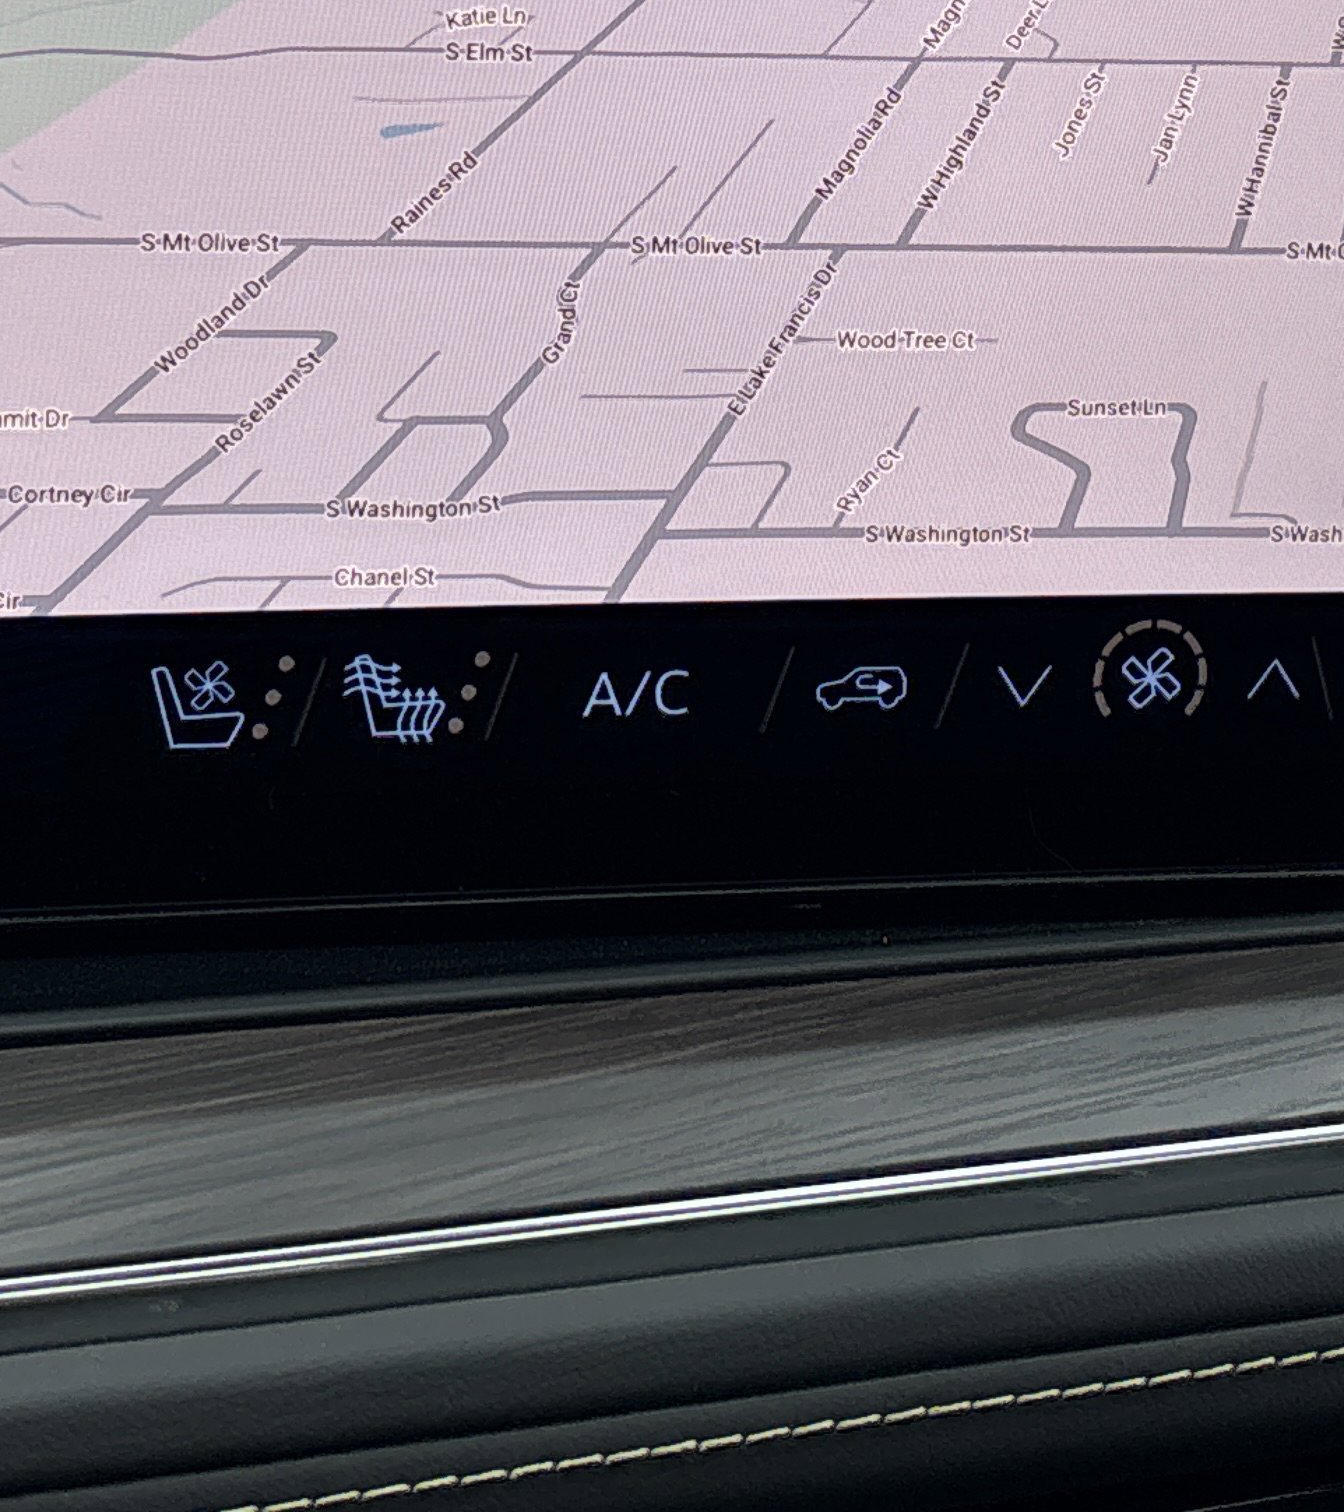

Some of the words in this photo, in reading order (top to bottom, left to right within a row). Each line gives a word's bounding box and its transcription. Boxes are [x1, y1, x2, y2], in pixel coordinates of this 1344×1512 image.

[447, 8, 496, 28] Katie
[503, 7, 526, 25] Ln
[1006, 10, 1039, 50] Deer
[446, 44, 459, 60] S
[467, 44, 501, 61] Elm
[511, 44, 533, 62] St
[1167, 75, 1197, 122] Lynn
[1271, 79, 1290, 101] St
[1055, 92, 1093, 159] Jones
[1085, 71, 1106, 96] St
[816, 119, 883, 201] Magnolia
[876, 87, 902, 116] Rd
[917, 188, 939, 210] W
[931, 102, 991, 190] Highland
[984, 79, 1006, 104] St
[1154, 120, 1181, 163] Jan
[1243, 105, 1283, 197] Hannibal
[391, 176, 452, 233] Raines
[449, 151, 477, 180] Rd
[1236, 195, 1254, 217] W
[141, 234, 156, 252] S
[162, 234, 192, 252] Mt
[198, 233, 252, 252] Olive
[257, 233, 279, 252] St
[559, 279, 580, 302] Ct
[156, 291, 247, 373] Woodland
[243, 274, 268, 299] Dr
[542, 305, 577, 365] Grand
[728, 396, 746, 416] E
[739, 354, 776, 404] Lake
[768, 285, 823, 356] Francis
[814, 262, 837, 287] Dr
[837, 331, 895, 349] Wood
[903, 332, 946, 349] Tree
[953, 332, 974, 349] Ct
[46, 410, 69, 429] Dr
[215, 372, 301, 453] Roselawn
[295, 352, 321, 376] St
[1068, 398, 1136, 416] Sunset
[1143, 399, 1166, 416] Ln
[9, 486, 93, 507] Cortney
[100, 485, 131, 504] Cir
[837, 468, 879, 514] Ryan
[875, 448, 901, 471] Ct
[327, 500, 340, 518] S
[347, 498, 472, 521] Washington
[479, 494, 500, 513] St
[335, 567, 407, 586] Chanel
[413, 568, 435, 586] St
[584, 667, 689, 718] A/C
